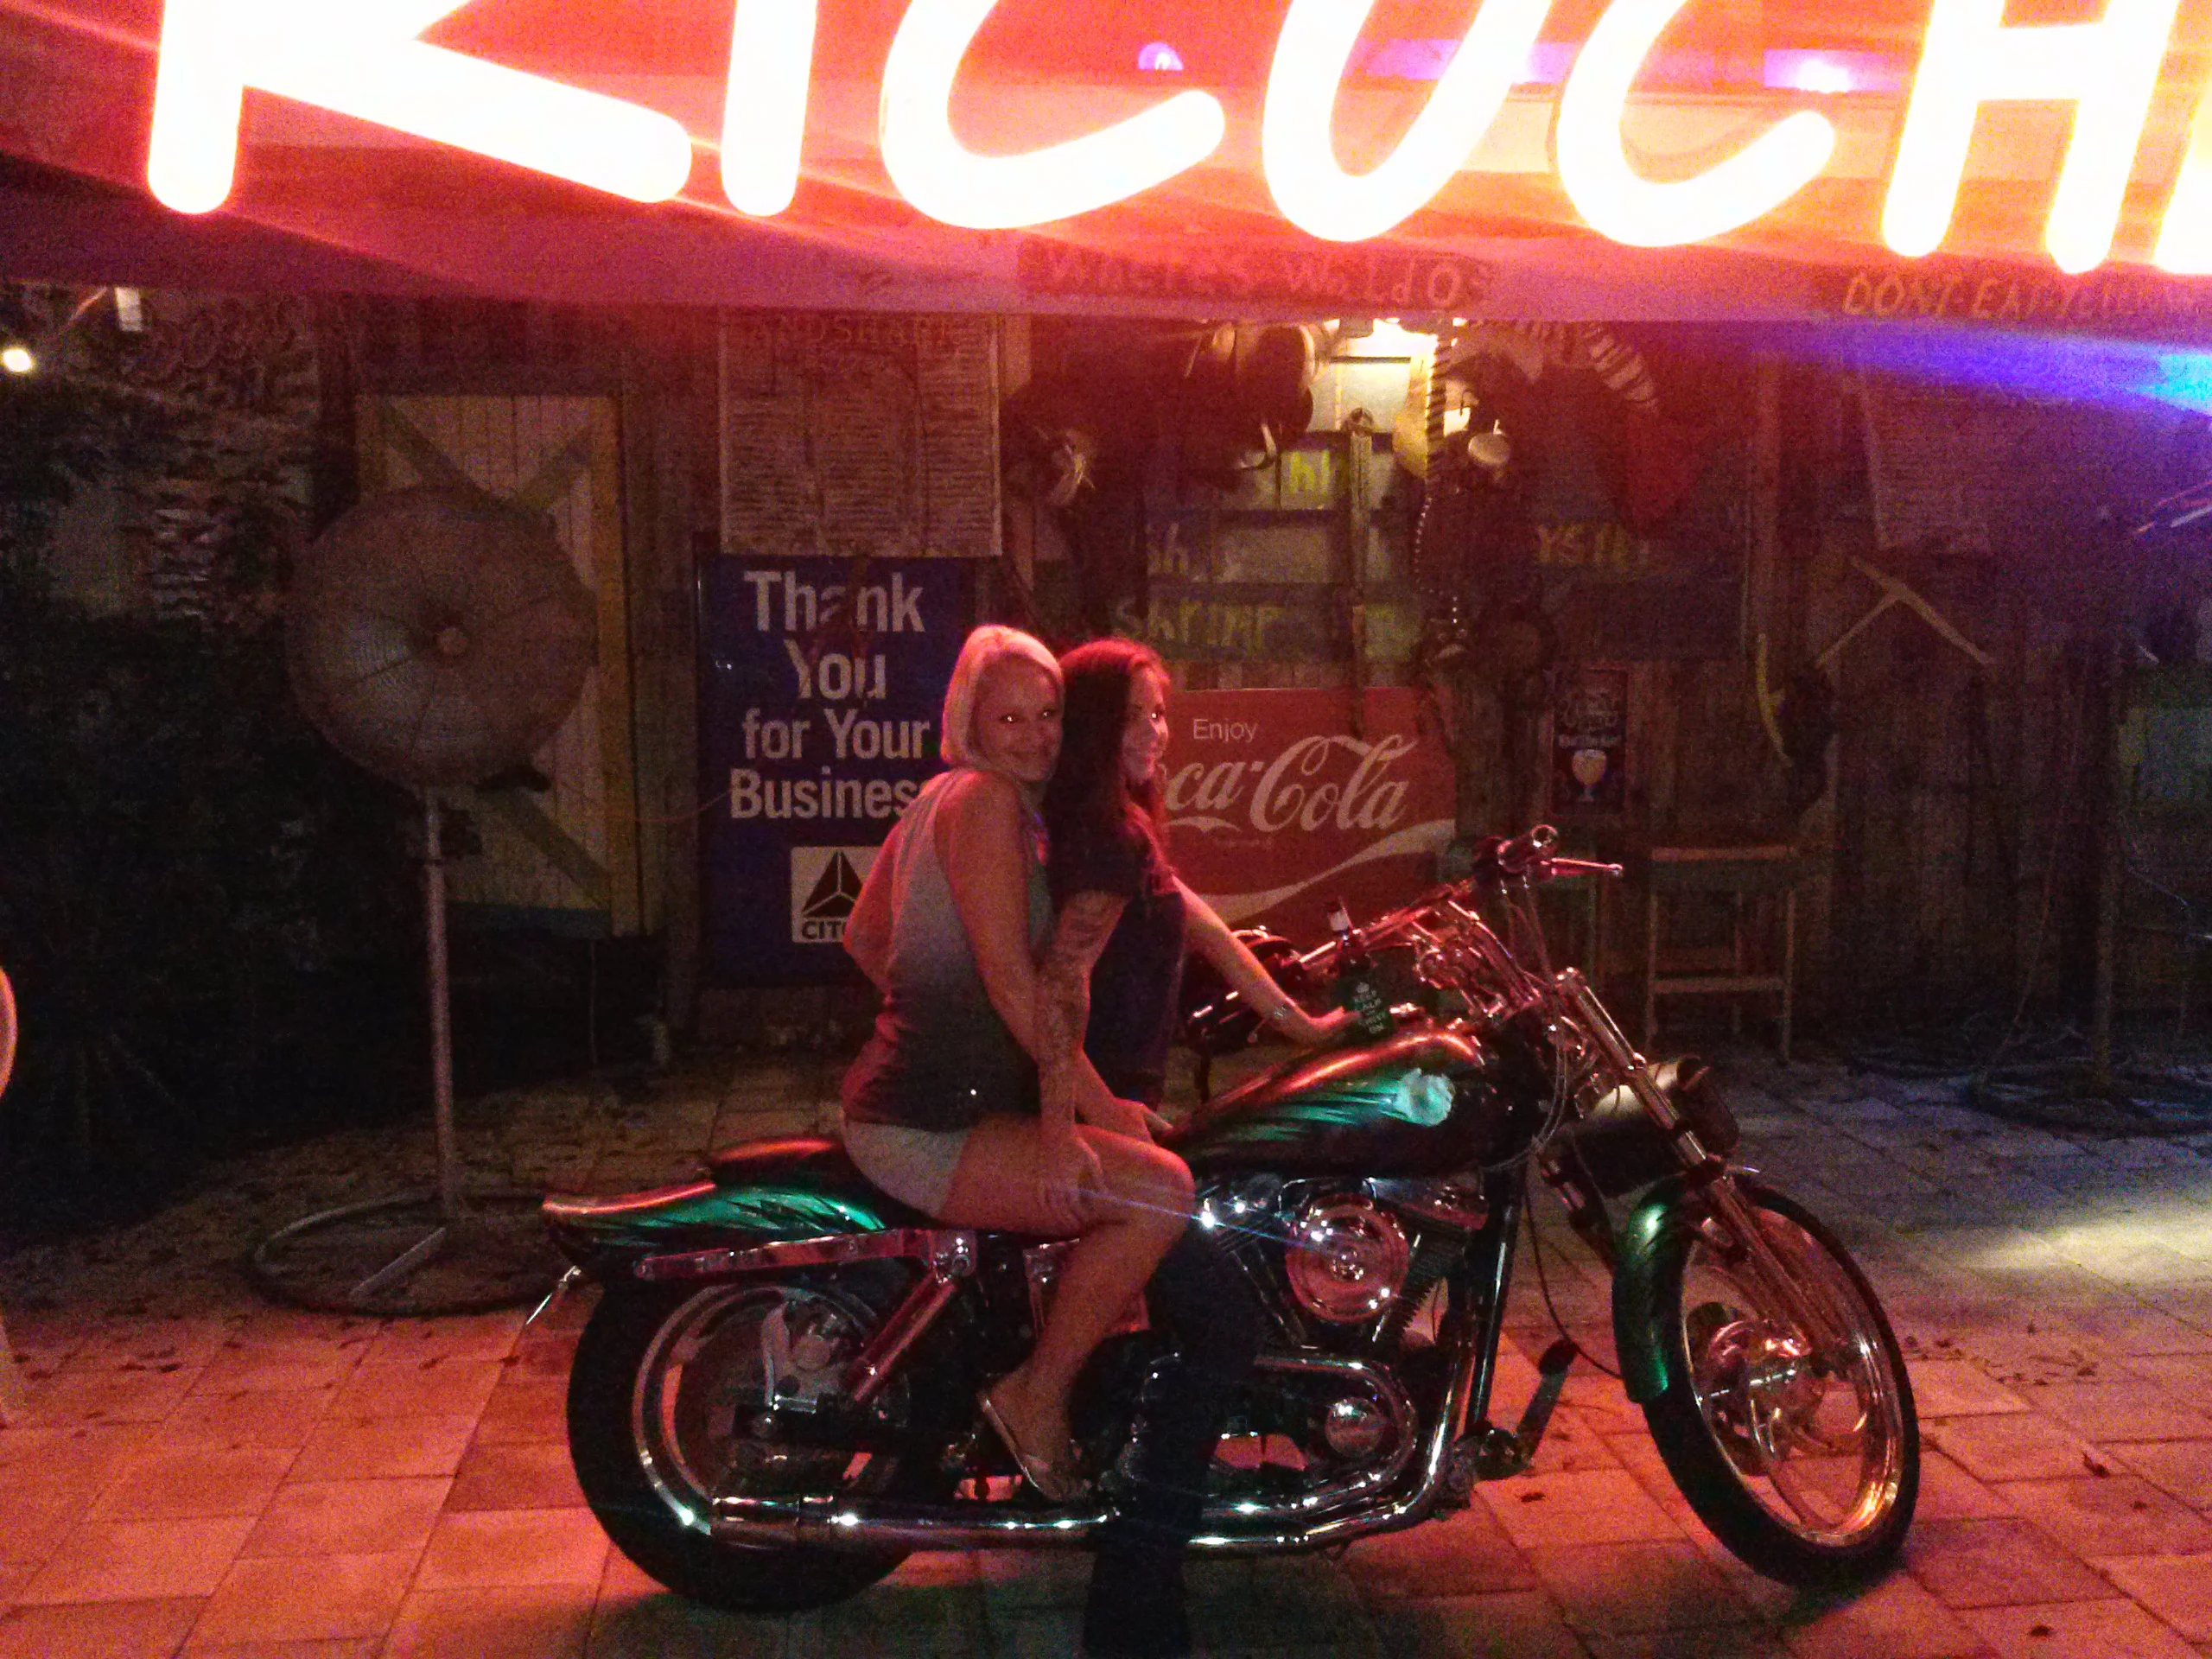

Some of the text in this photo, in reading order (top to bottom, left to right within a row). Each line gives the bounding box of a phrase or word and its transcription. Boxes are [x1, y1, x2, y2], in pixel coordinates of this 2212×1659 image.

[744, 570, 925, 632] Thank
[784, 639, 887, 700] You
[741, 708, 931, 760] for Your
[1192, 718, 1258, 743] Enjoy
[729, 766, 918, 819] Busines
[1157, 734, 1419, 833] ca-Cola
[801, 921, 844, 940] CIT
